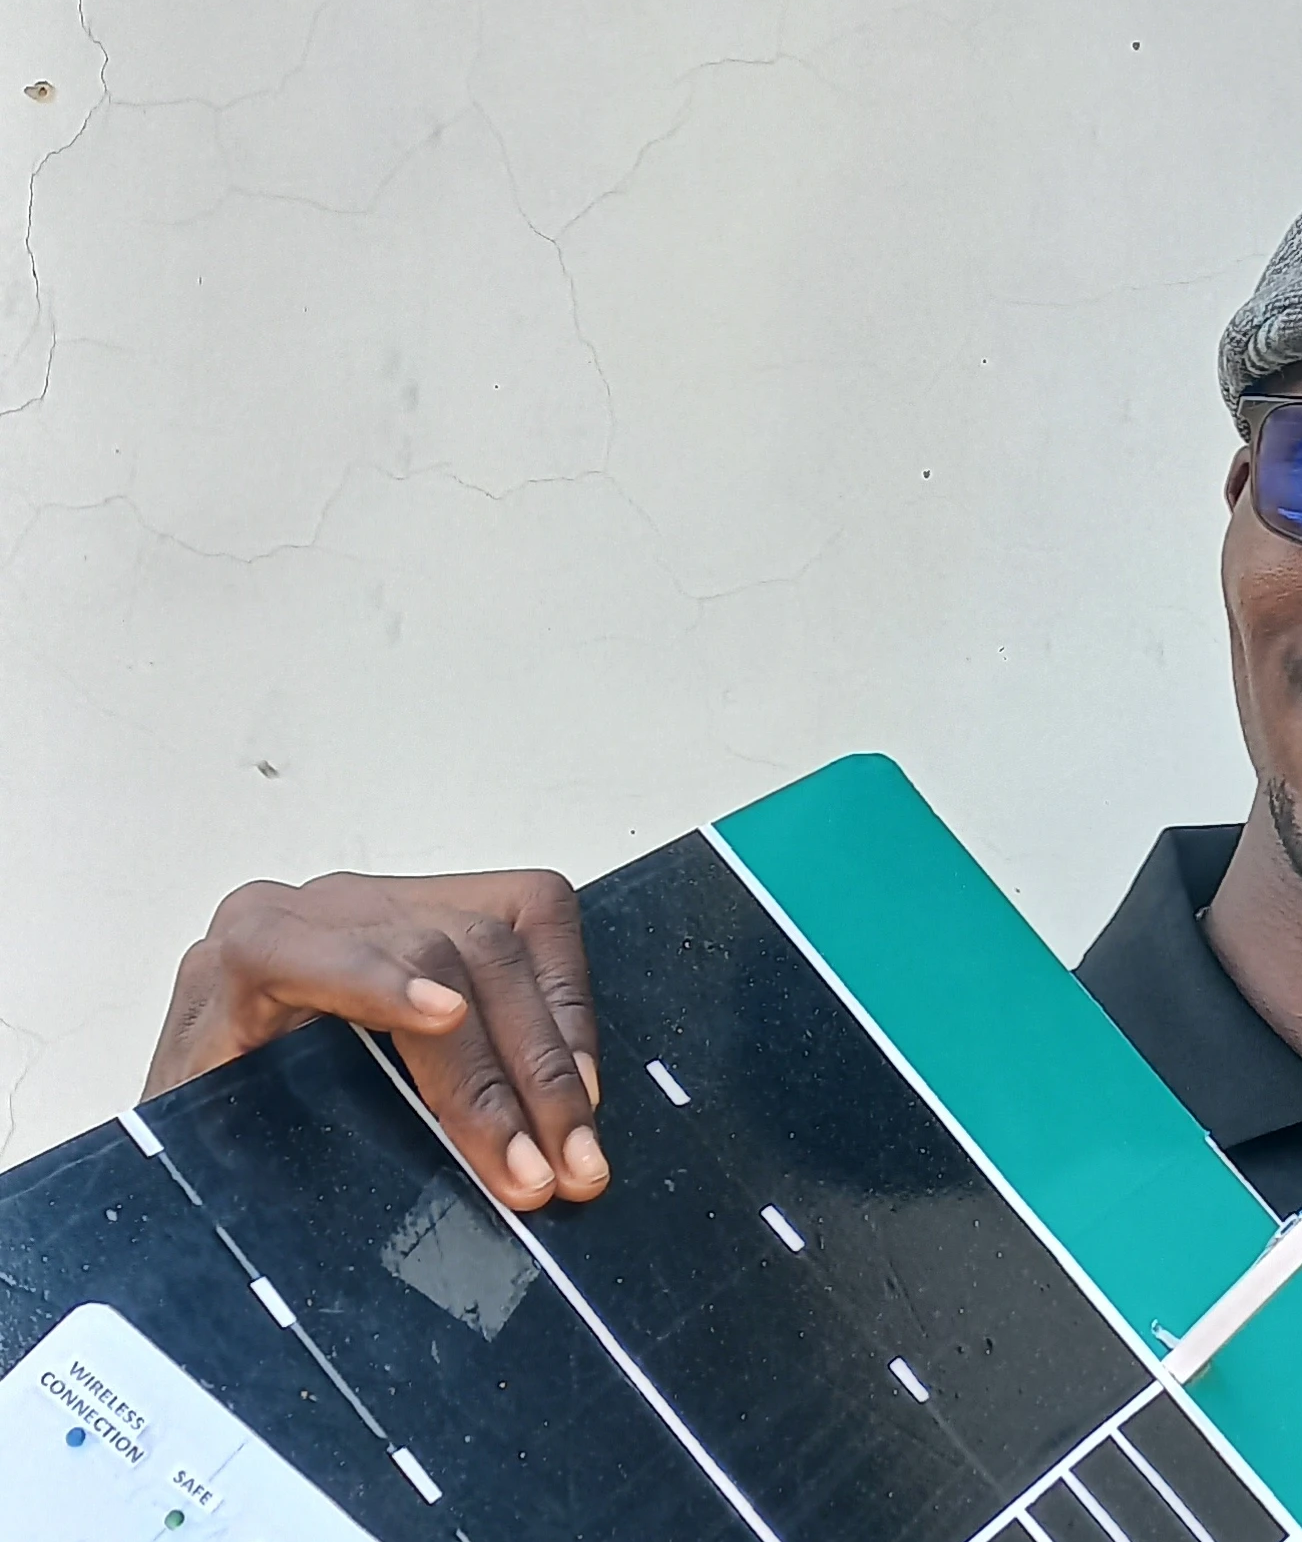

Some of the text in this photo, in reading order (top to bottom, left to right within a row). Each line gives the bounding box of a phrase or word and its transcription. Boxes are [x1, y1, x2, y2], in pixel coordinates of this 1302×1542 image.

[40, 1371, 145, 1463] CONNECTION
[69, 1360, 145, 1430] WIRELESS
[172, 1469, 213, 1506] SAFE
